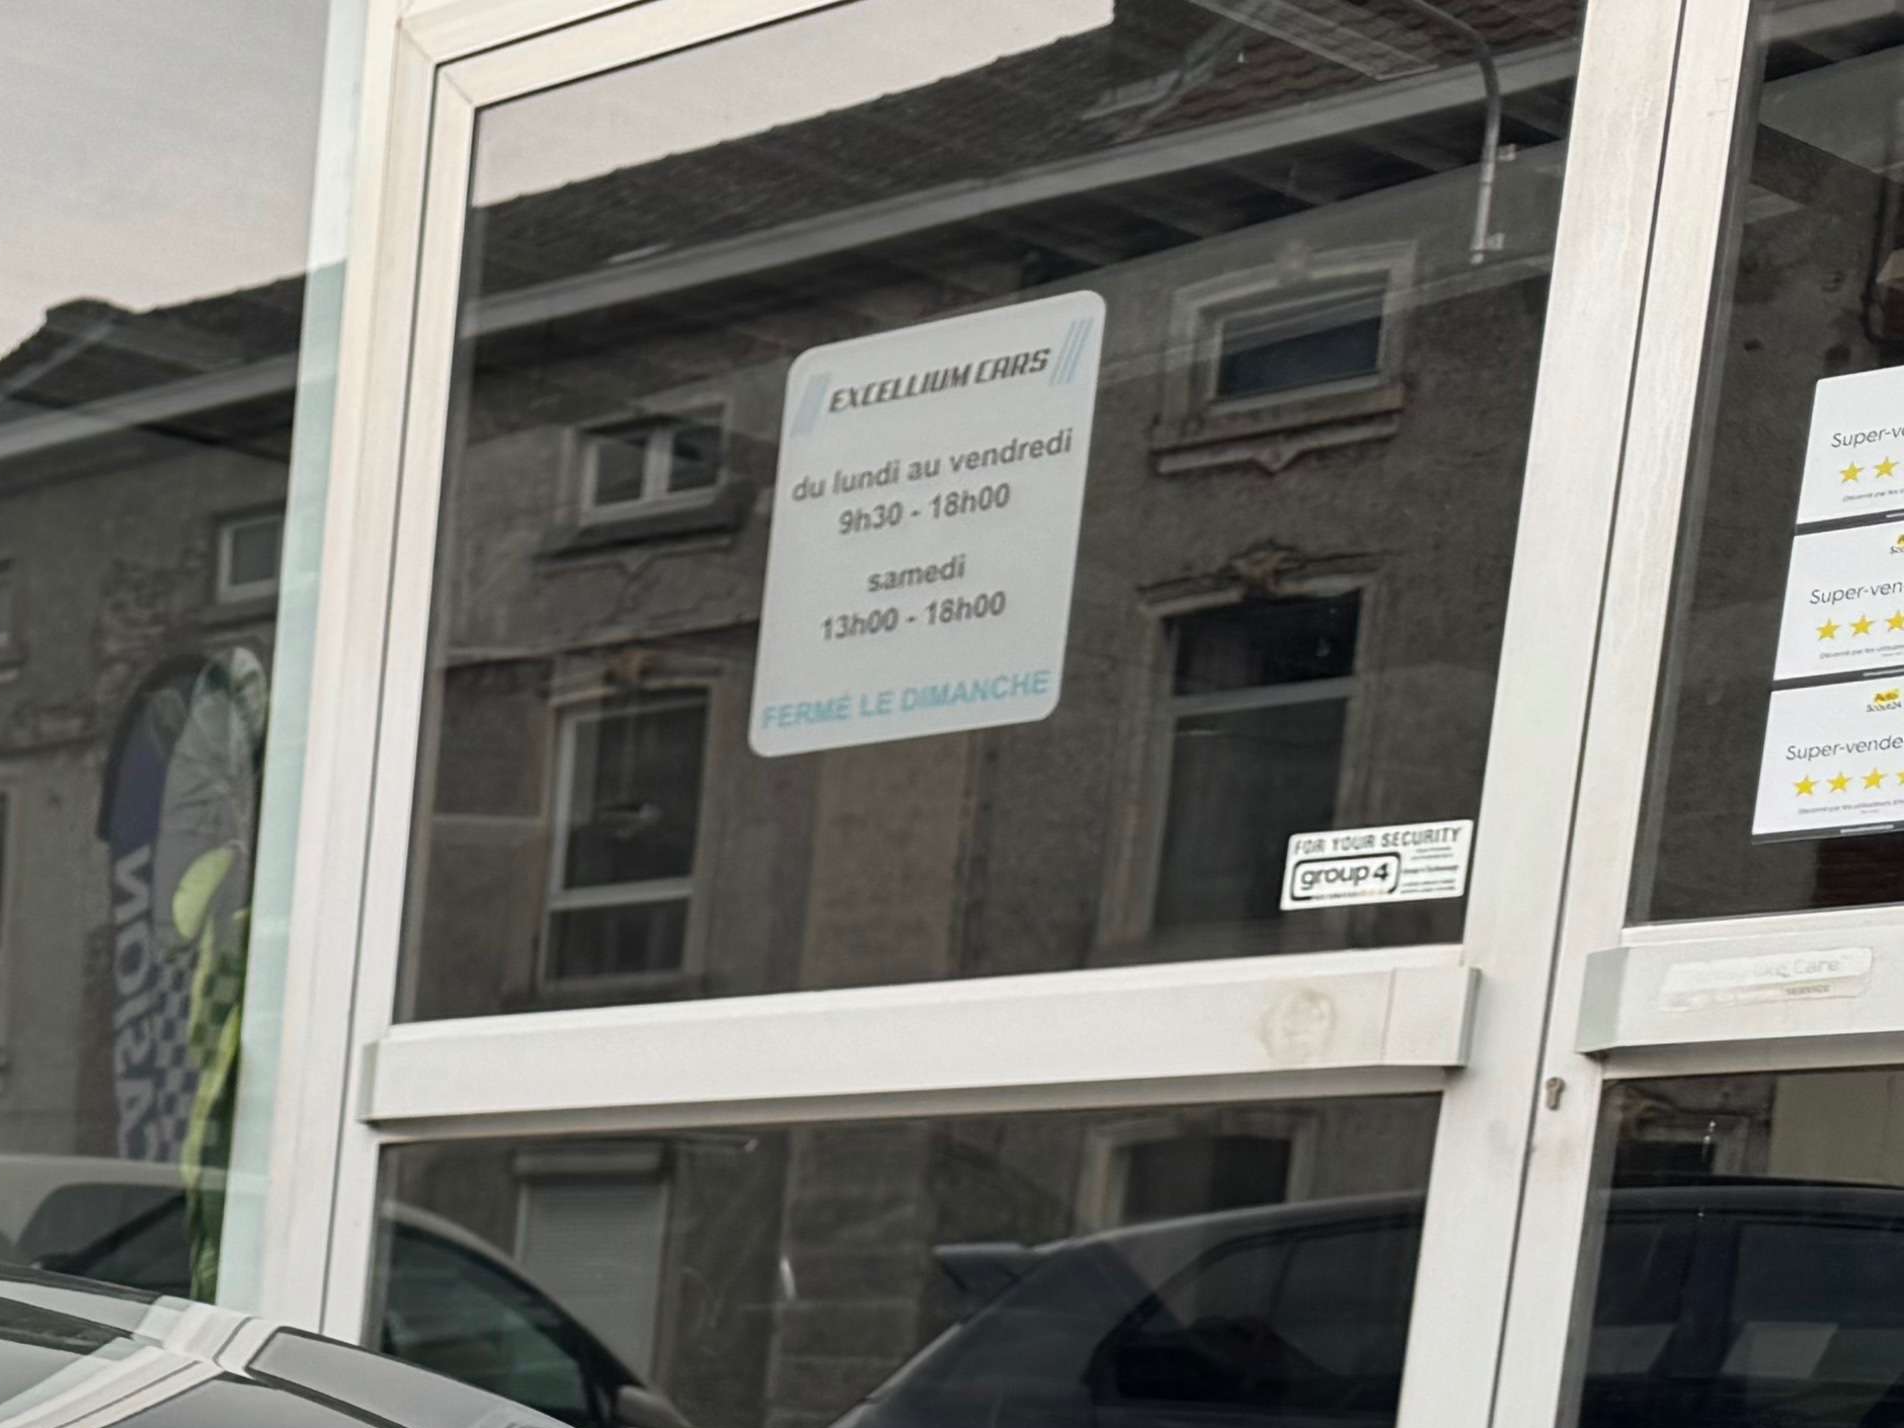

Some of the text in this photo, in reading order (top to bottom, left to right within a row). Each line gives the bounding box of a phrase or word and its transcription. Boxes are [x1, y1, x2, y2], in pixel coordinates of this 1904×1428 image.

[829, 348, 1052, 414] EXCELLIUM CARS
[1831, 426, 1904, 449] Super-v
[792, 428, 1074, 501] du lundi au vendredi
[838, 502, 903, 535] 9h30
[931, 483, 1011, 519] 18h00
[867, 553, 967, 593] samedi
[1809, 581, 1904, 605] Super-ven
[821, 607, 900, 641] 13h00
[926, 590, 1007, 626] 18h00
[859, 690, 895, 717] LE
[900, 669, 1053, 713] DIMANCHE
[1294, 827, 1463, 855] FOR YOUR SECURITY
